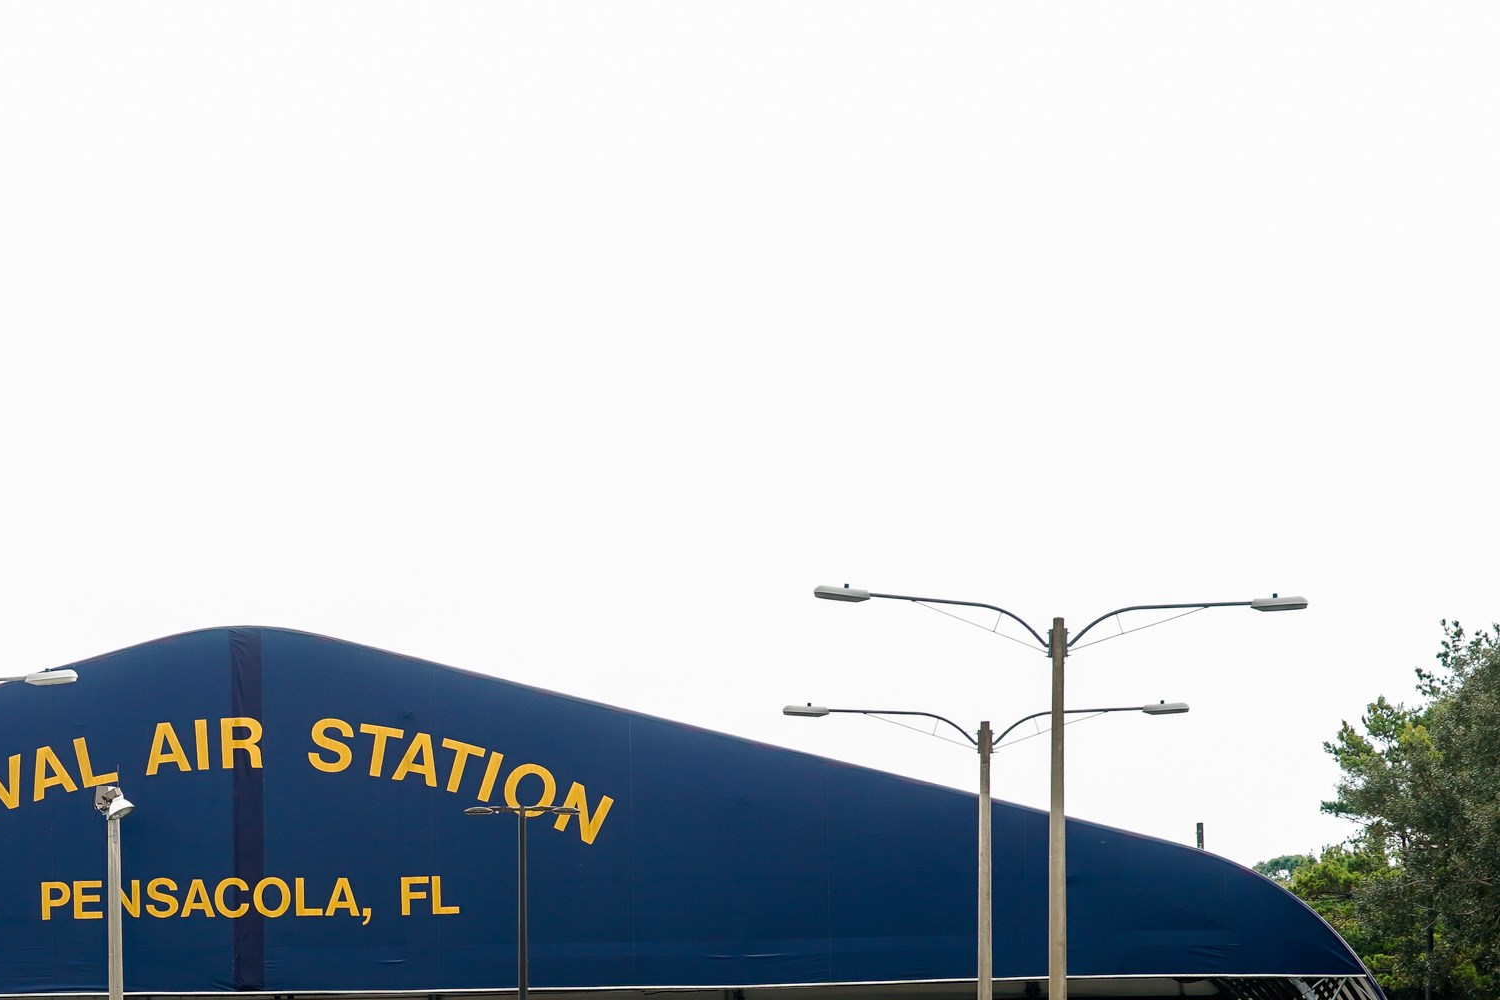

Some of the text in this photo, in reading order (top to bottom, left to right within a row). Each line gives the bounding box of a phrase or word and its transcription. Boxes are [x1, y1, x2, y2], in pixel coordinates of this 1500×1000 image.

[146, 717, 263, 775] AIR
[307, 717, 615, 845] STATION
[40, 876, 460, 926] PENSACOLA, FL
